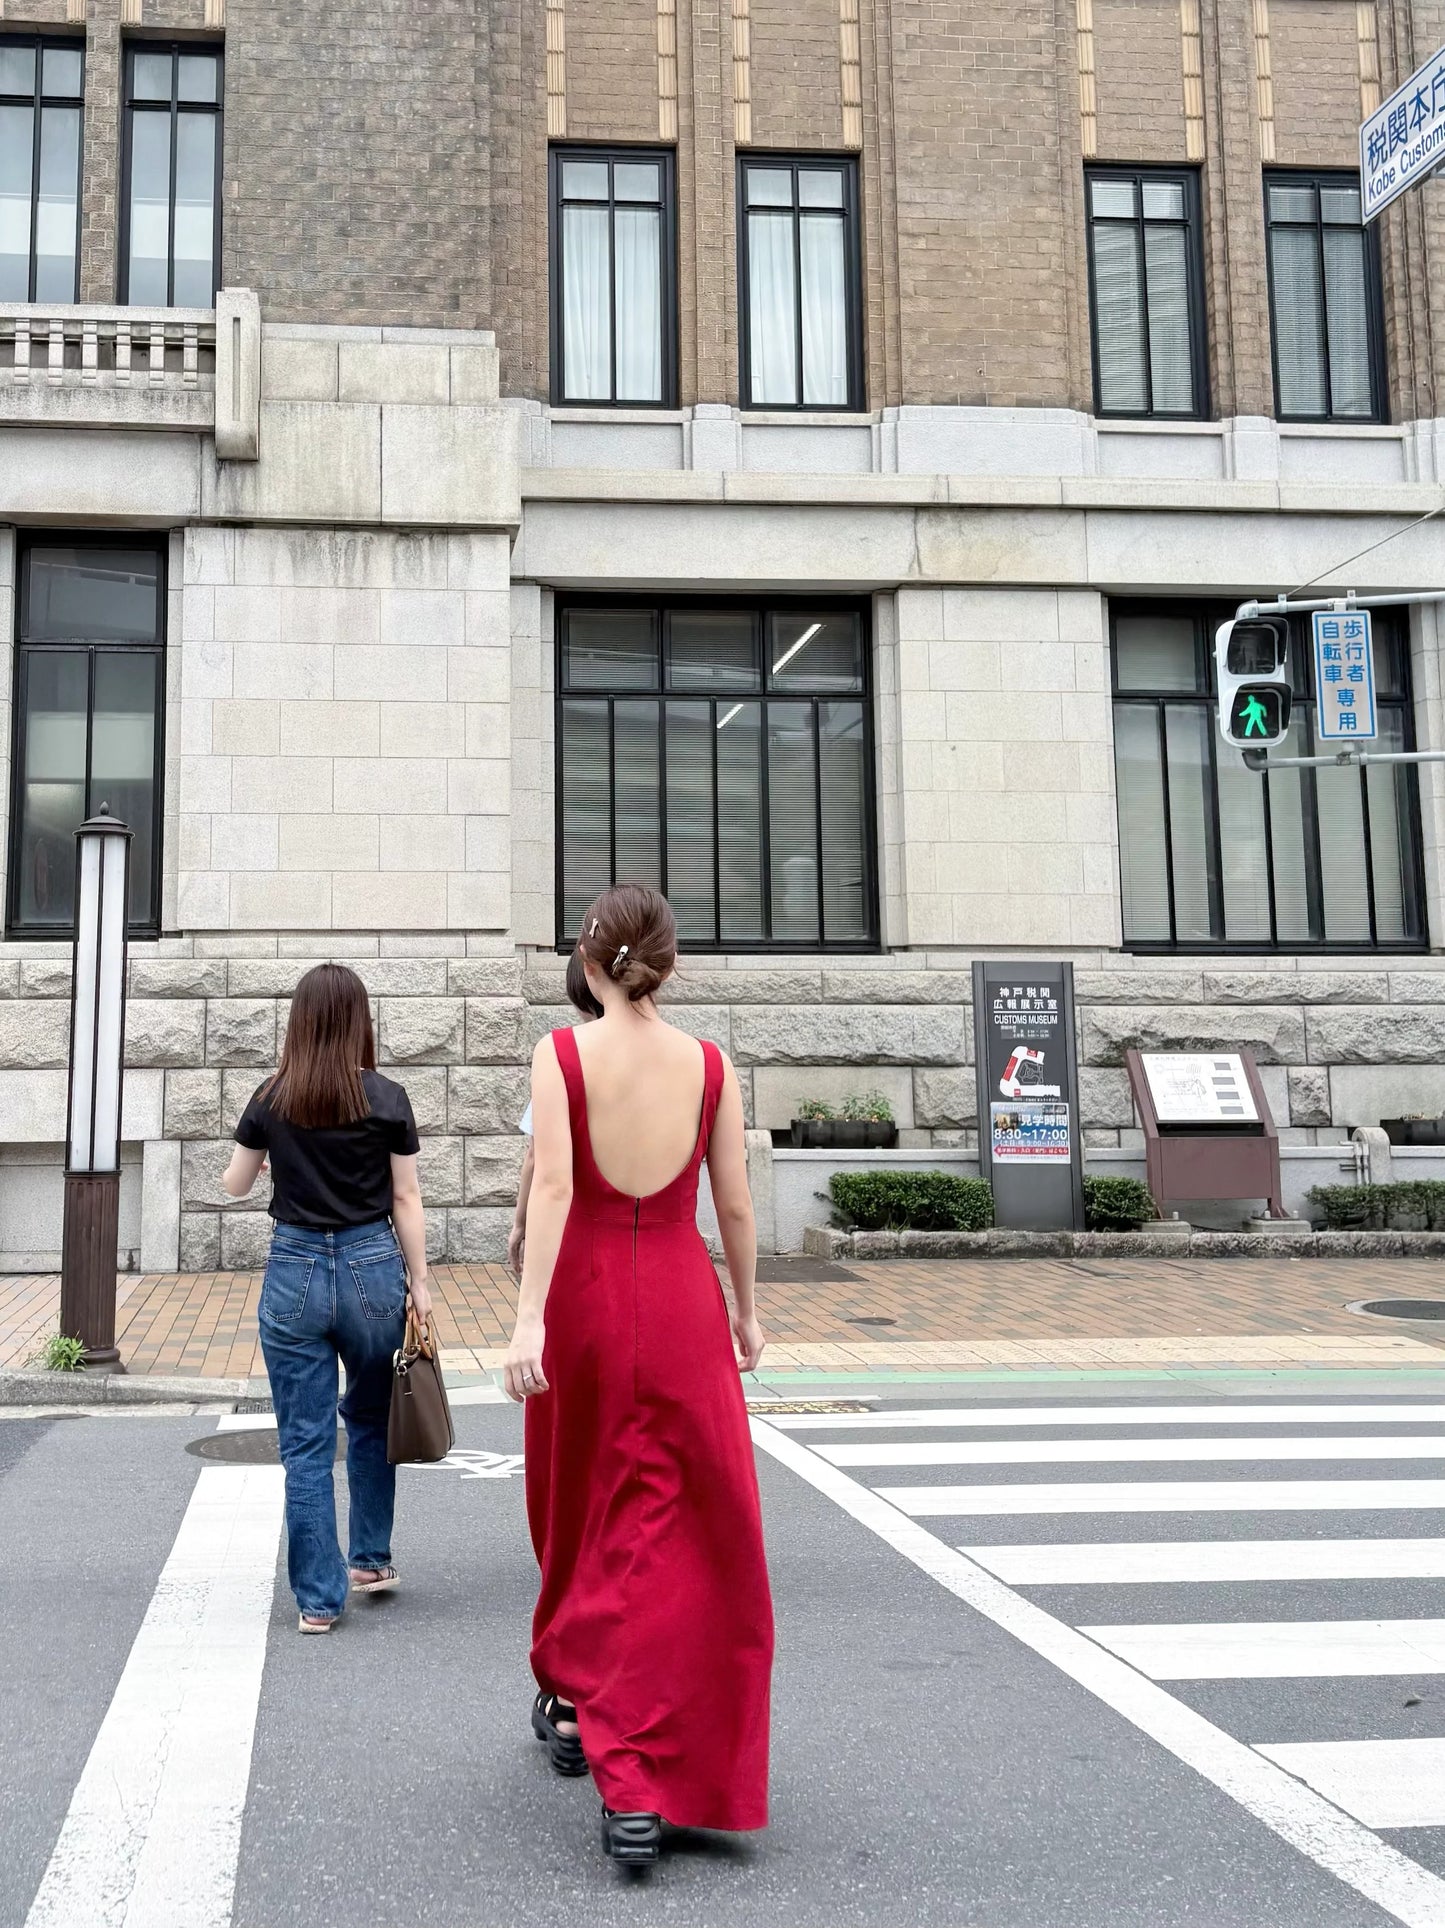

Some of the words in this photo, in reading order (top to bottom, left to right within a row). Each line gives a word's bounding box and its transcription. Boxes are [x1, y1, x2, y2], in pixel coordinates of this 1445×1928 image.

[1368, 168, 1396, 203] Kobe
[1322, 621, 1343, 683] 自転車
[1343, 620, 1365, 682] 歩行者
[1337, 688, 1357, 731] 専用
[993, 999, 1058, 1010] 広報展示室
[999, 987, 1051, 998] 神戸税関
[994, 1014, 1027, 1025] CUSTOMS
[1028, 1014, 1058, 1025] MUSEUM
[1020, 1114, 1068, 1127] 見学時間
